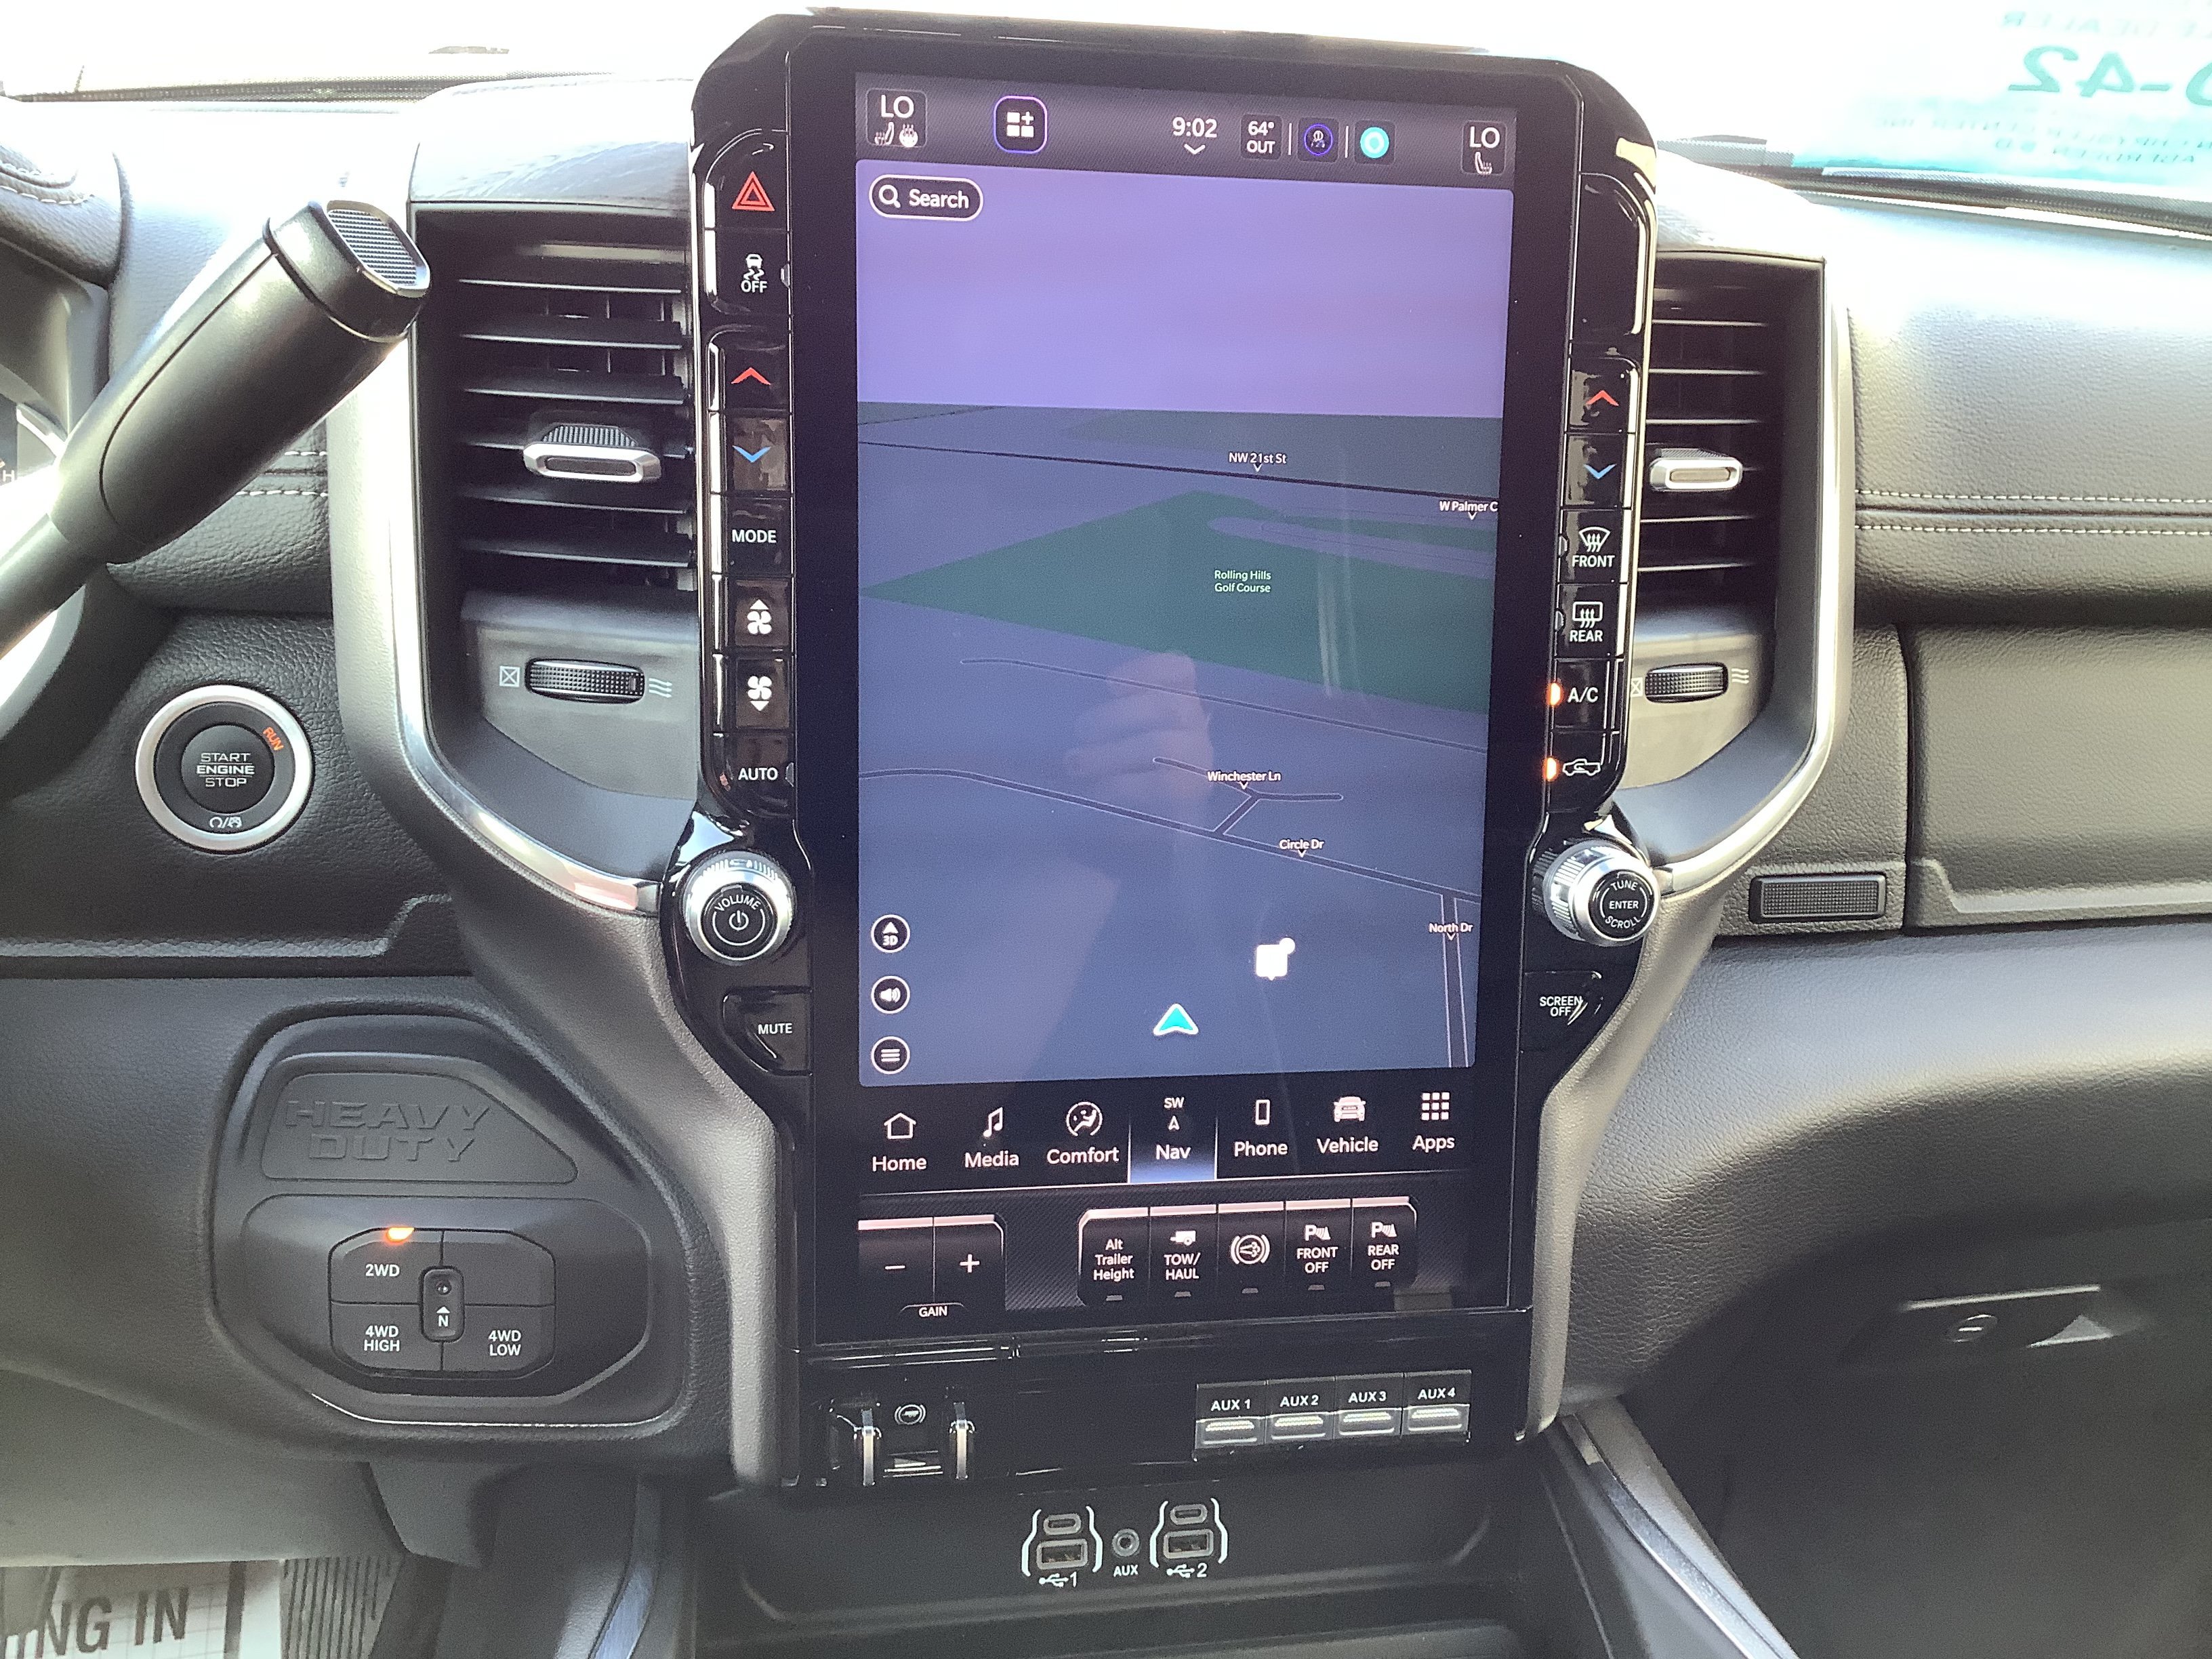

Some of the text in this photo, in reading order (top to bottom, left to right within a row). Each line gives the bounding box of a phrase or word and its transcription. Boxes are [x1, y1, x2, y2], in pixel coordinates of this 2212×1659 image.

[880, 94, 914, 119] LO
[1172, 117, 1217, 138] 9:02
[1248, 121, 1275, 136] 64°
[1469, 126, 1500, 149] LO
[1246, 140, 1276, 154] OUT
[909, 188, 969, 209] Search
[741, 280, 768, 293] OFF
[1229, 452, 1287, 464] NW 21st St
[1439, 500, 1498, 512] W Palmer C
[731, 529, 777, 544] MODE
[1571, 554, 1616, 569] FRONT
[1214, 569, 1271, 582] Rolling Hills
[1214, 582, 1271, 593] Golf Course
[1569, 630, 1603, 642] REAR
[1567, 687, 1599, 703] A/C
[262, 726, 285, 752] RUN
[201, 752, 251, 762] START
[195, 764, 255, 775] ENGINE
[737, 767, 778, 781] AUTO
[1207, 771, 1282, 782] Winchester Ln
[205, 777, 247, 787] STOP
[1279, 838, 1325, 850] Circle Dr
[1610, 878, 1639, 891] TUNE
[714, 895, 762, 913] VOLUME
[1609, 900, 1639, 909] ENTER
[1429, 921, 1474, 933] North Dr
[1603, 914, 1643, 929] SCROLL
[1539, 996, 1582, 1007] SCREEN
[1550, 1006, 1570, 1017] OFF
[758, 1023, 793, 1035] MUTE
[1164, 1097, 1185, 1109] SW
[283, 1098, 491, 1130] HEAVY
[308, 1132, 476, 1162] DUTY
[1234, 1141, 1288, 1157] Phone
[1316, 1136, 1378, 1153] Vehicle
[1412, 1134, 1455, 1153] Apps
[964, 1150, 1019, 1168] Media
[1046, 1146, 1120, 1164] Comfort
[1155, 1144, 1191, 1160] Nav
[872, 1155, 927, 1172] Home
[1105, 1238, 1124, 1250] Alt
[1368, 1244, 1399, 1256] REAR
[1094, 1252, 1134, 1266] Trailer
[1163, 1252, 1201, 1266] TOW/
[1296, 1246, 1338, 1260] FRONT
[365, 1263, 400, 1277] 2WD
[1305, 1261, 1329, 1273] OFF
[1370, 1258, 1395, 1271] OFF
[1093, 1267, 1134, 1282] Height
[1165, 1267, 1200, 1281] HAUL
[918, 1307, 947, 1317] GAIN
[438, 1314, 450, 1327] N
[365, 1325, 399, 1338] 4WD
[488, 1329, 522, 1342] 4WD
[363, 1339, 400, 1352] HIGH
[489, 1343, 521, 1356] LOW
[1347, 1391, 1387, 1404] AUX 3
[1417, 1387, 1456, 1400] AUX 4
[1210, 1399, 1250, 1412] AUX 1
[1279, 1394, 1319, 1408] AUX 2
[1113, 1564, 1139, 1578] AUX
[1196, 1562, 1208, 1578] 2
[1068, 1571, 1077, 1588] 1
